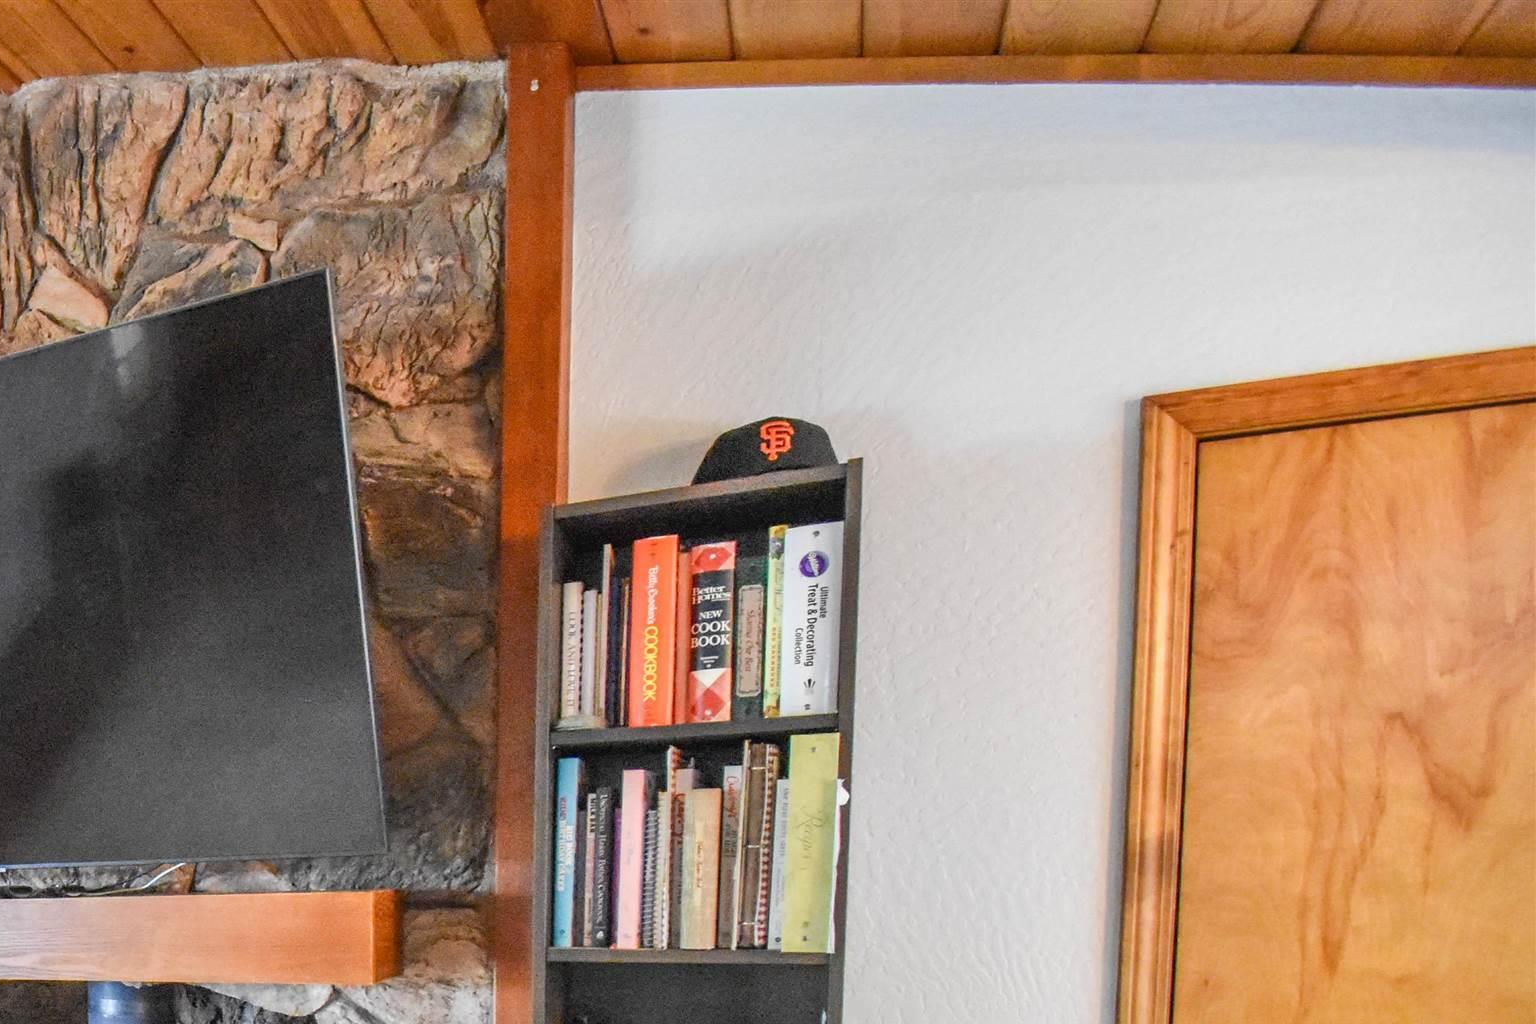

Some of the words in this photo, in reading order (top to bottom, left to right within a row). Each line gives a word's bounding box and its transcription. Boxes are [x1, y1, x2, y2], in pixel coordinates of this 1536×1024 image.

[759, 419, 795, 461] SF
[692, 585, 726, 596] Better
[692, 593, 731, 605] Homes
[807, 583, 818, 607] Treat
[819, 586, 829, 619] Ultimate
[699, 610, 724, 620] NEW
[691, 620, 731, 635] COOK
[691, 634, 730, 649] BOOK
[794, 628, 804, 665] Collection
[804, 617, 818, 667] Decorating
[642, 625, 659, 702] COOKBOOK
